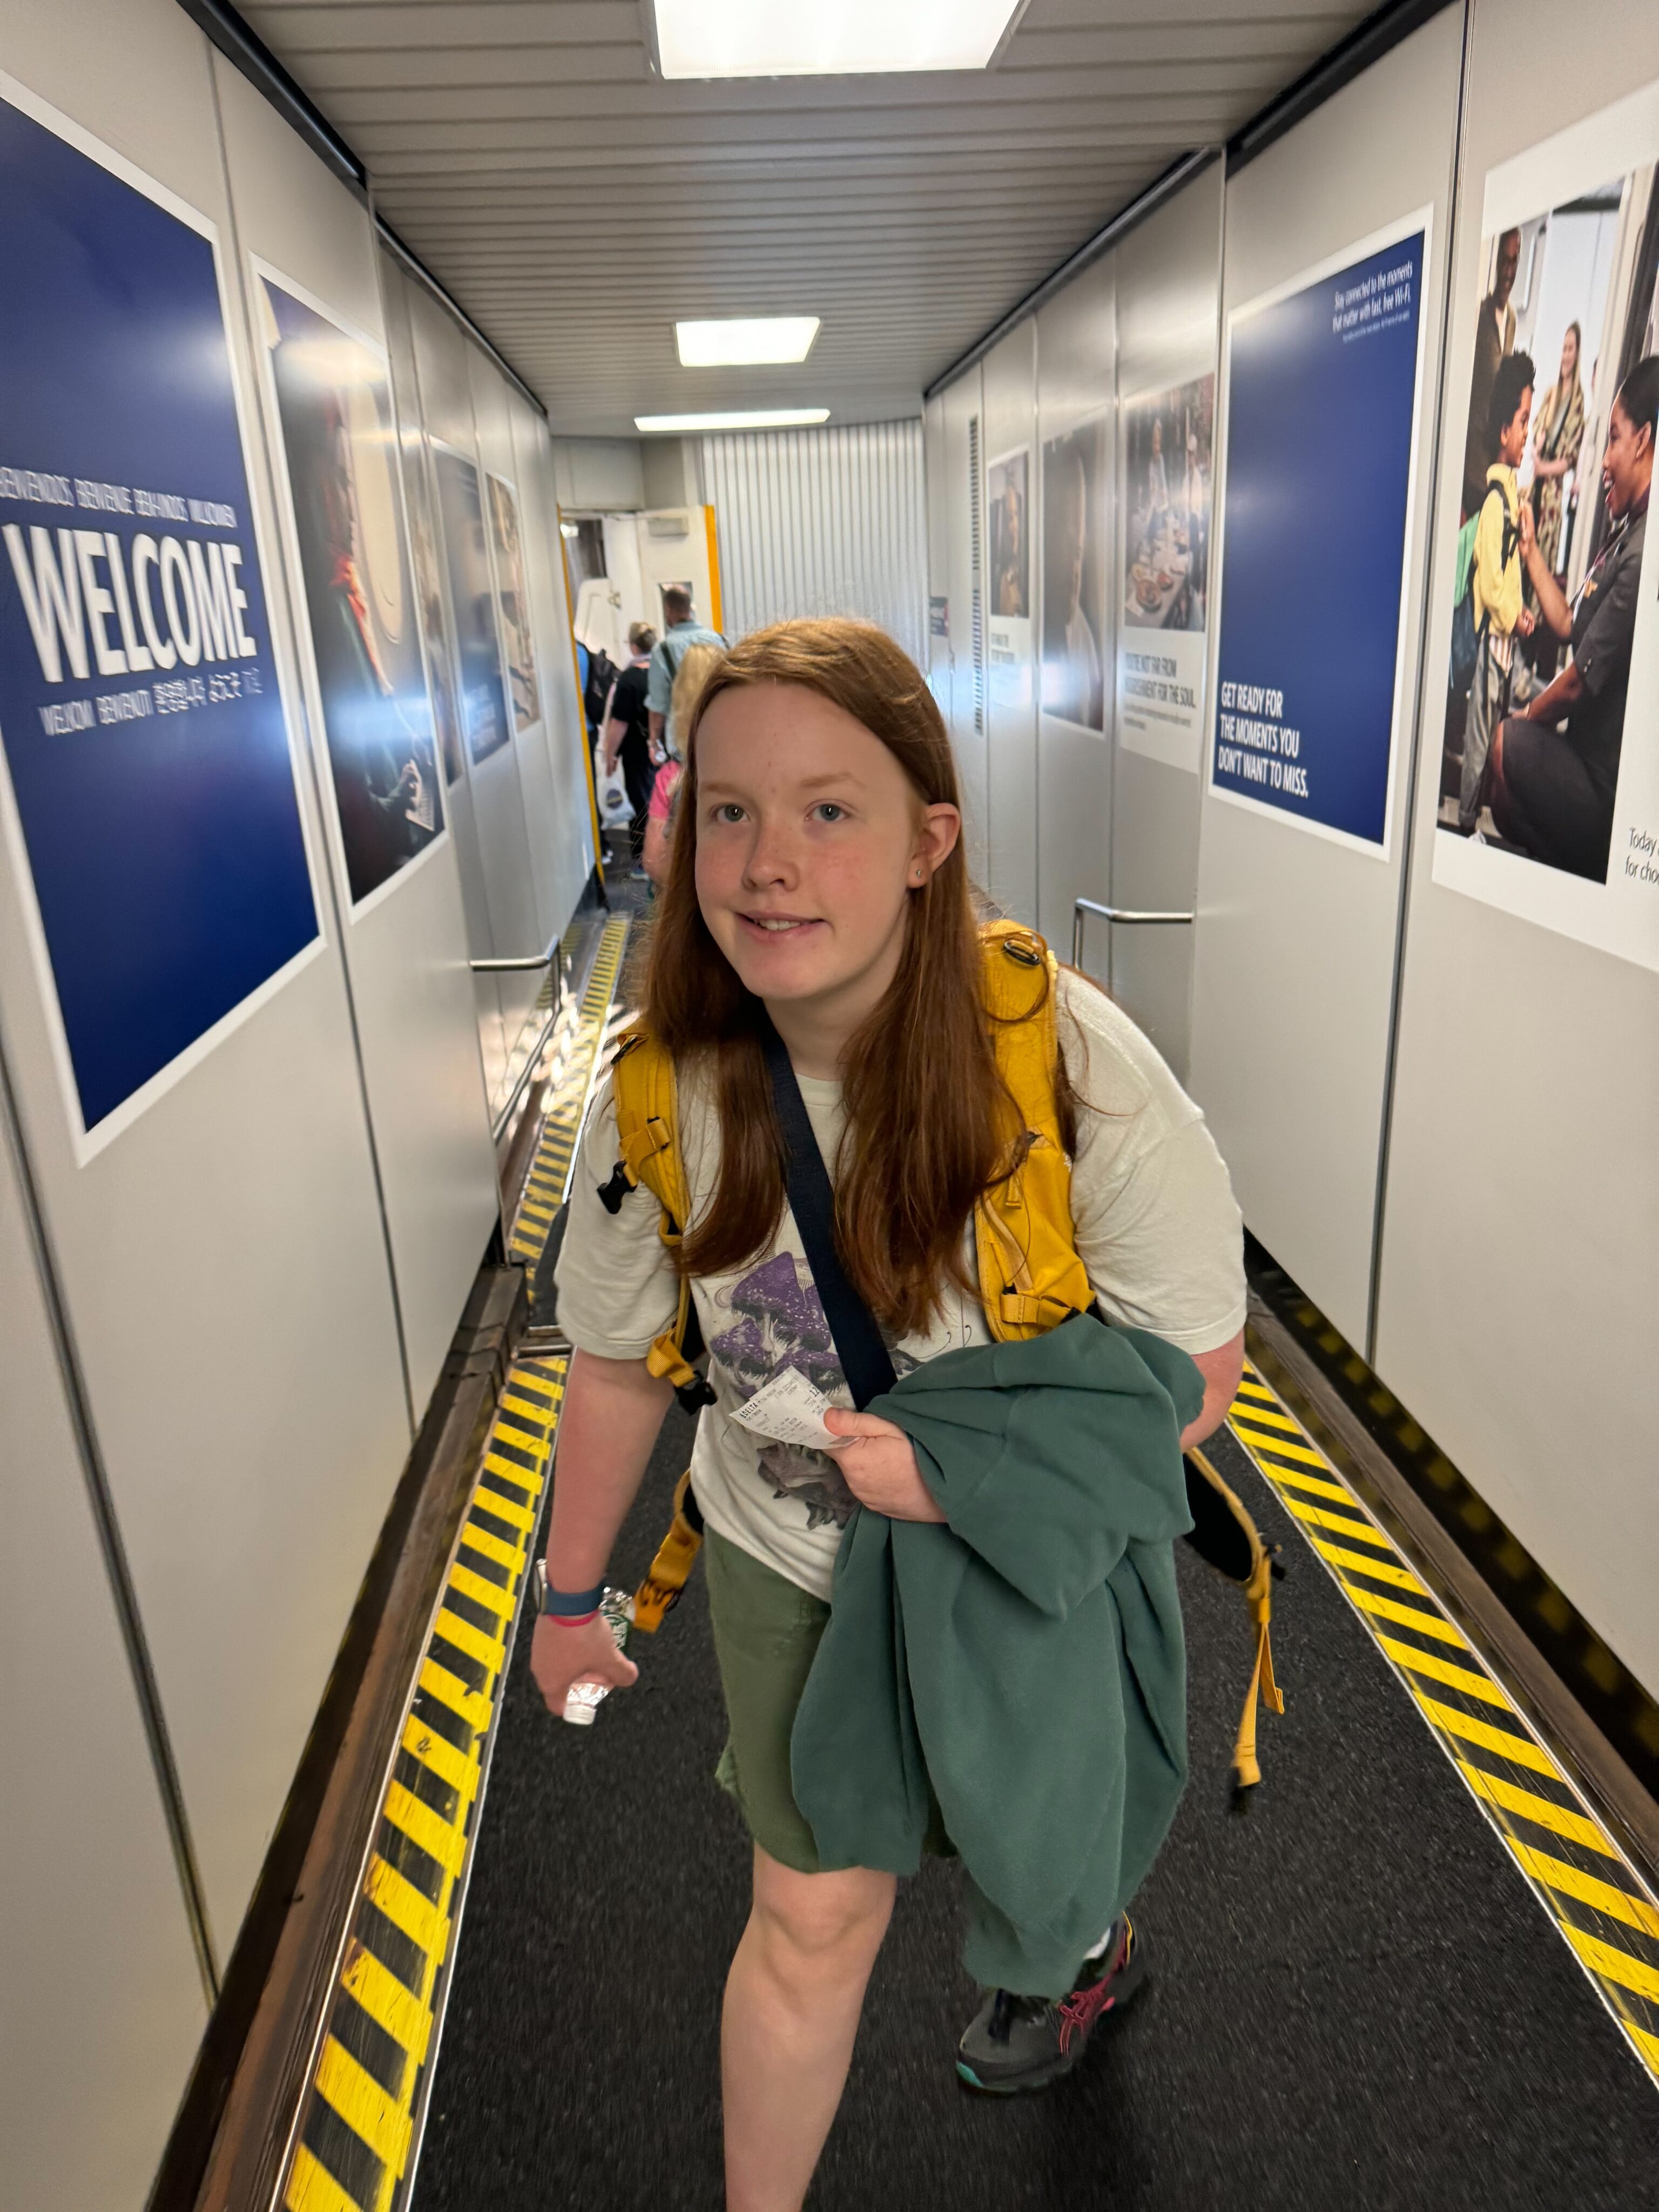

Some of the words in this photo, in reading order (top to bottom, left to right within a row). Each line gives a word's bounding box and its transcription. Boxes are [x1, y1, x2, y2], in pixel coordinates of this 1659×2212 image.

[1371, 276, 1377, 294] to
[1378, 271, 1386, 292] the
[1387, 260, 1413, 287] moments
[1383, 291, 1394, 313] free
[2, 523, 257, 683] WELCOME
[1221, 681, 1237, 709] GET
[1237, 684, 1264, 715] READY
[1265, 689, 1283, 719] FOR
[1220, 713, 1235, 741] THE
[1236, 717, 1277, 753] MOMENTS
[1280, 727, 1299, 758] YOU
[1218, 745, 1242, 776] DON'T
[1243, 752, 1268, 785] WANT
[1270, 759, 1282, 789] TO
[1283, 764, 1309, 798] MISS.
[1629, 827, 1657, 857] Today
[1625, 855, 1638, 878] for
[1640, 861, 1659, 884] cho
[810, 1387, 820, 1397] 12
[742, 1402, 759, 1417] DELTA
